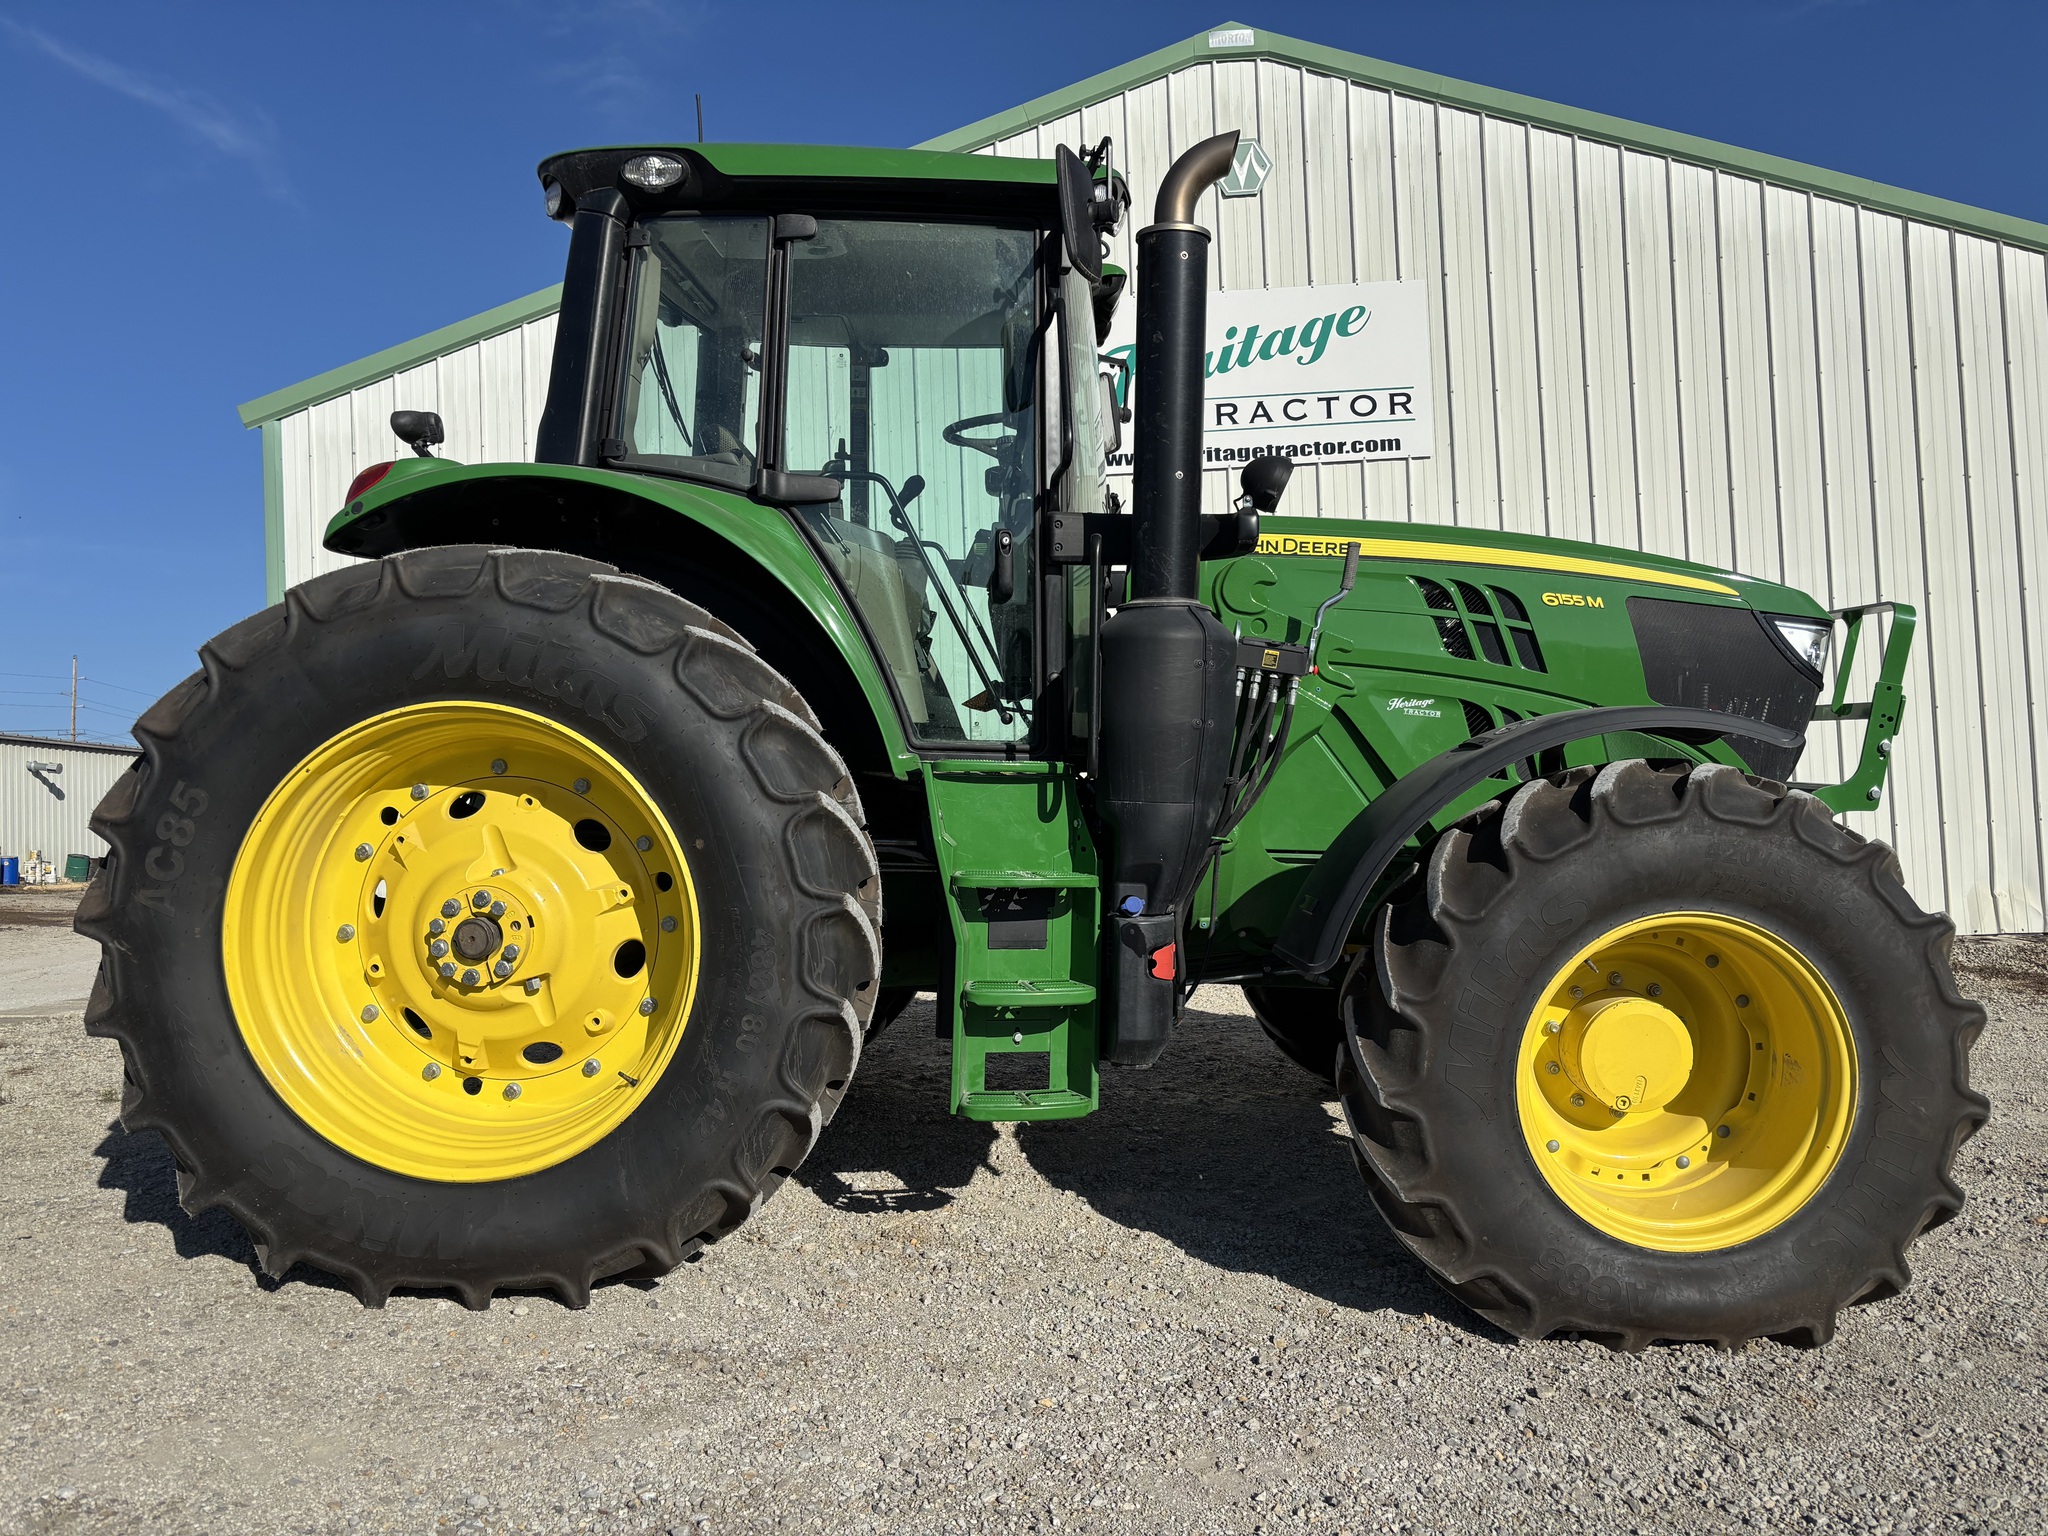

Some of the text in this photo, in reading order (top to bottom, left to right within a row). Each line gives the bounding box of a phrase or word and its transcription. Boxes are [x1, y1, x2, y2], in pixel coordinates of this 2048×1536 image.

[1215, 392, 1413, 426] RACTOR
[1255, 539, 1279, 552] HN
[412, 622, 660, 743] Mitas
[1387, 697, 1435, 711] Heritage
[1404, 708, 1441, 718] TRACTOR
[132, 779, 209, 919] AC85
